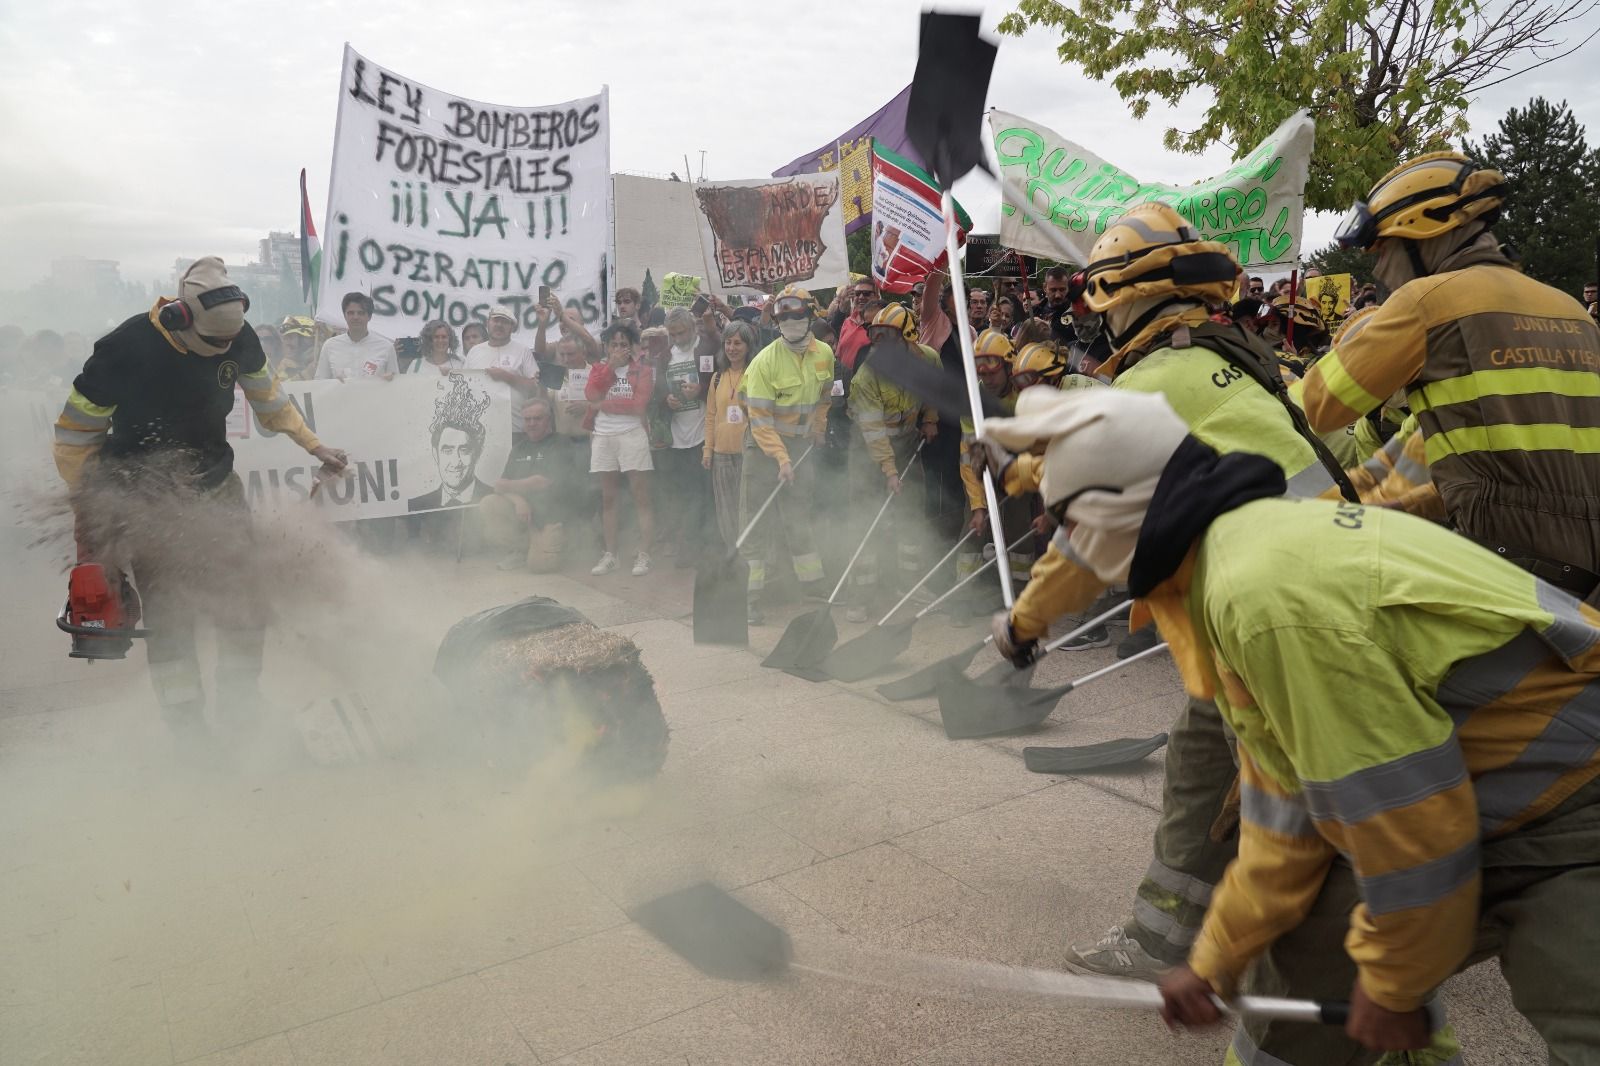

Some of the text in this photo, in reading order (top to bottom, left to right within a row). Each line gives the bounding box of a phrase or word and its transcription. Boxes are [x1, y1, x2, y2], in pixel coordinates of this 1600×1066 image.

[349, 58, 600, 151] LEY BOMBEROS
[375, 119, 573, 194] FORESTALES
[770, 186, 830, 210] ARDE
[721, 239, 818, 265] ESPAÑA POR
[722, 266, 746, 283] LOS
[372, 284, 489, 328] SOMOS
[1513, 315, 1583, 334] JUNTA DE
[1491, 347, 1566, 365] CASTILLA
[1567, 349, 1577, 364] Y
[1211, 363, 1243, 388] CAS
